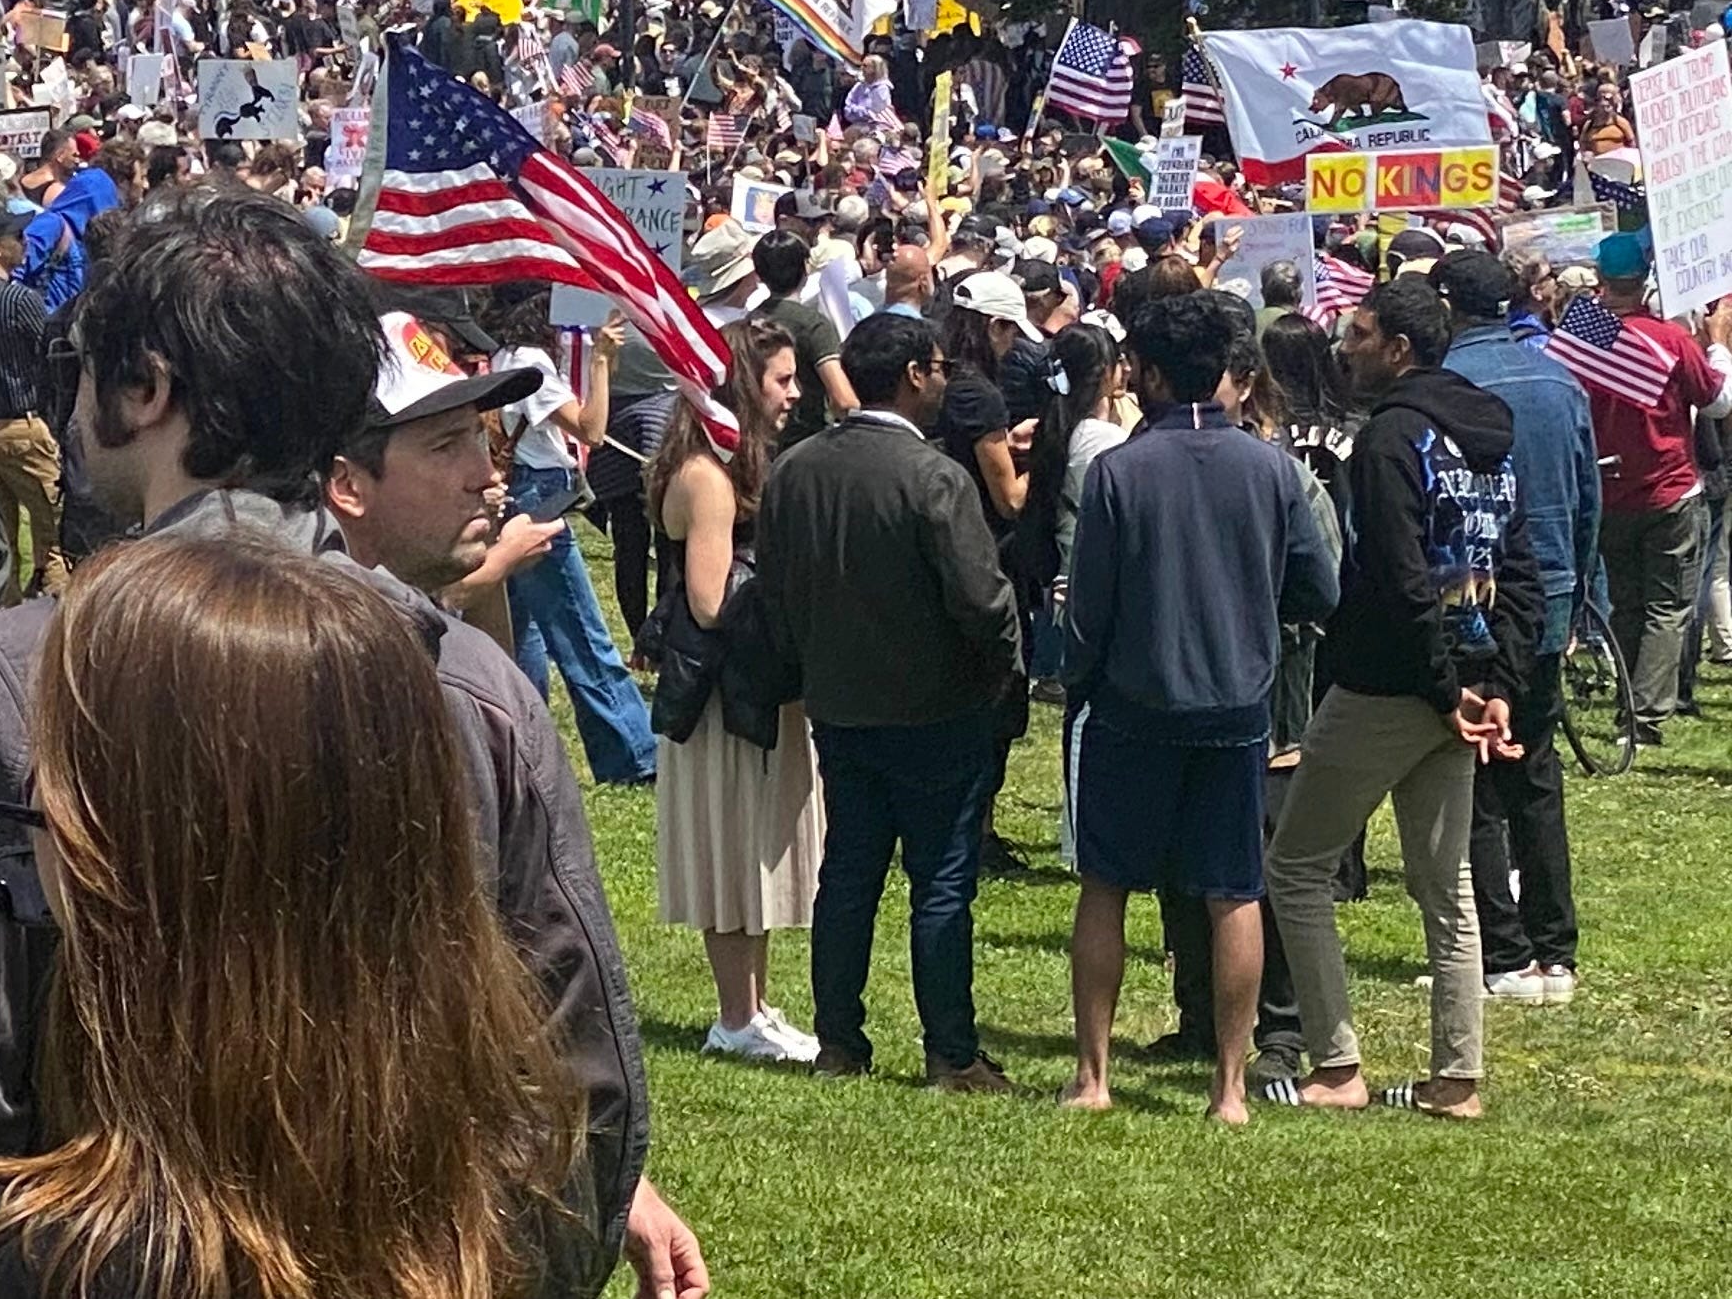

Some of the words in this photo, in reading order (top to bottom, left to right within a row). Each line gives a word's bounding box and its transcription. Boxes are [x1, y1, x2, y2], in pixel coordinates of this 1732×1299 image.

[1368, 128, 1431, 148] REPUBLIC
[590, 175, 645, 202] IGHT
[1312, 167, 1367, 200] NO
[1378, 161, 1495, 198] KINGS
[624, 206, 682, 235] RANCE
